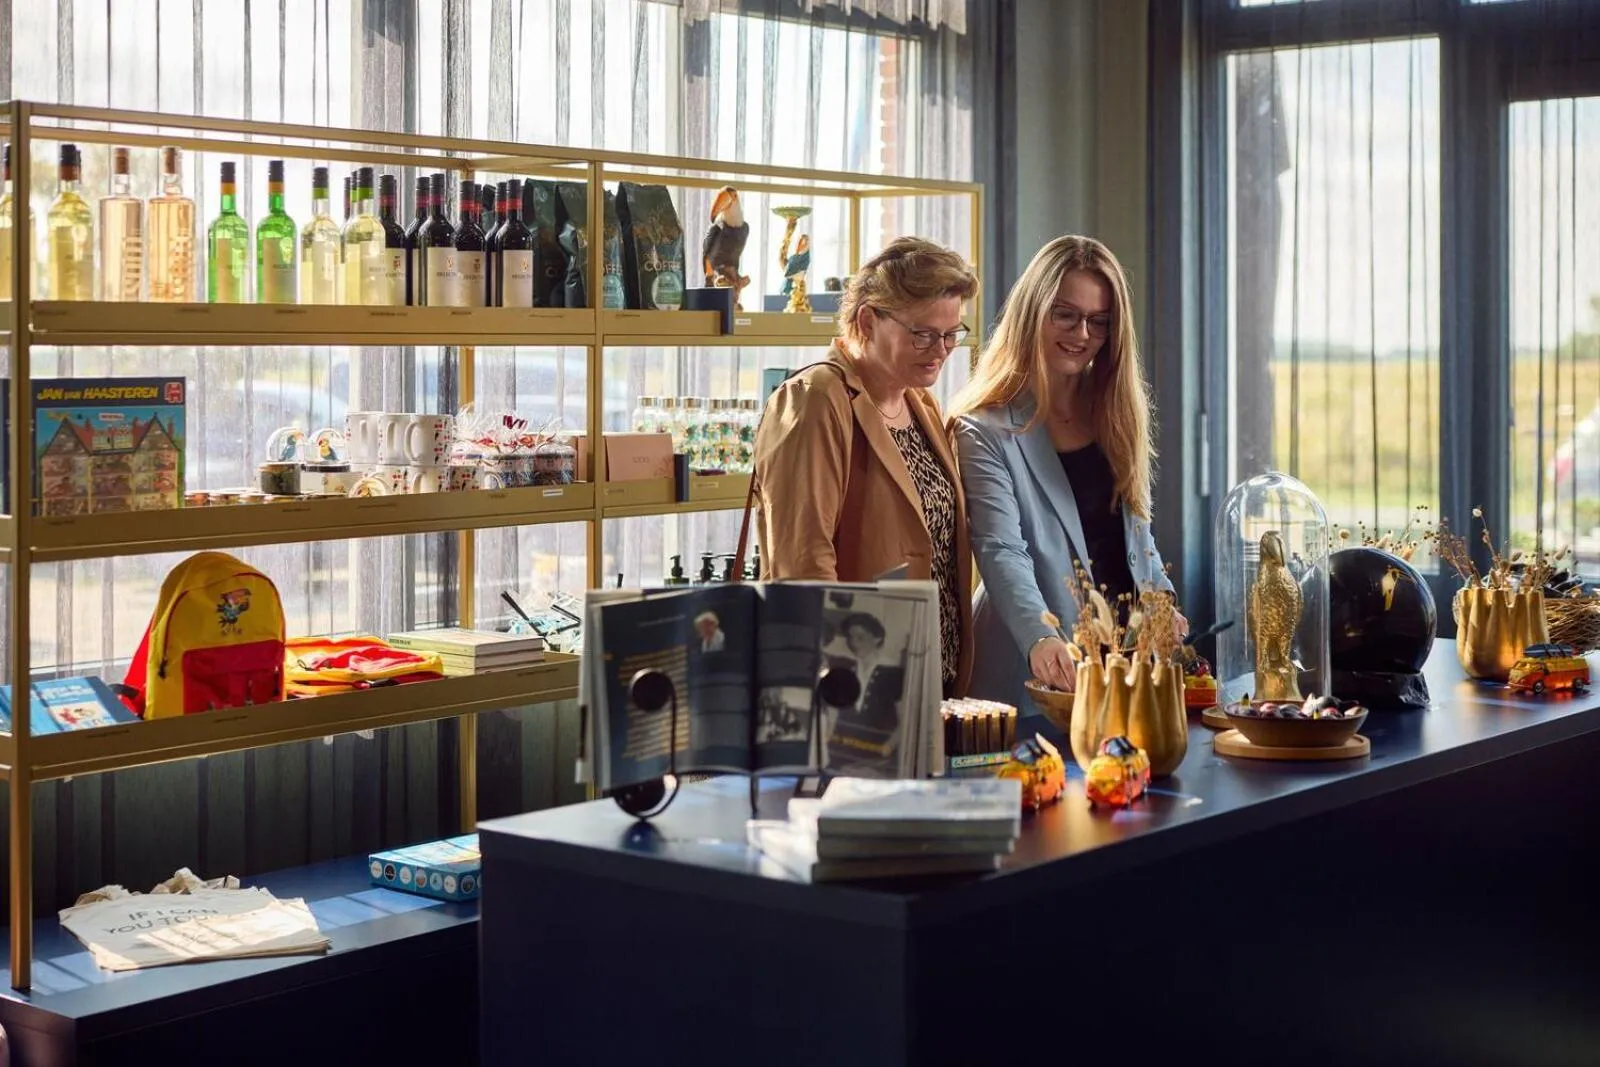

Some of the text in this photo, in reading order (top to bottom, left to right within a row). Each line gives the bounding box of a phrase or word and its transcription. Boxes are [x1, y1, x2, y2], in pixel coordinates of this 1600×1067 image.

[37, 387, 64, 400] JAN
[83, 386, 159, 400] HAASTEREN
[129, 911, 149, 921] IF
[102, 920, 153, 934] YOU
